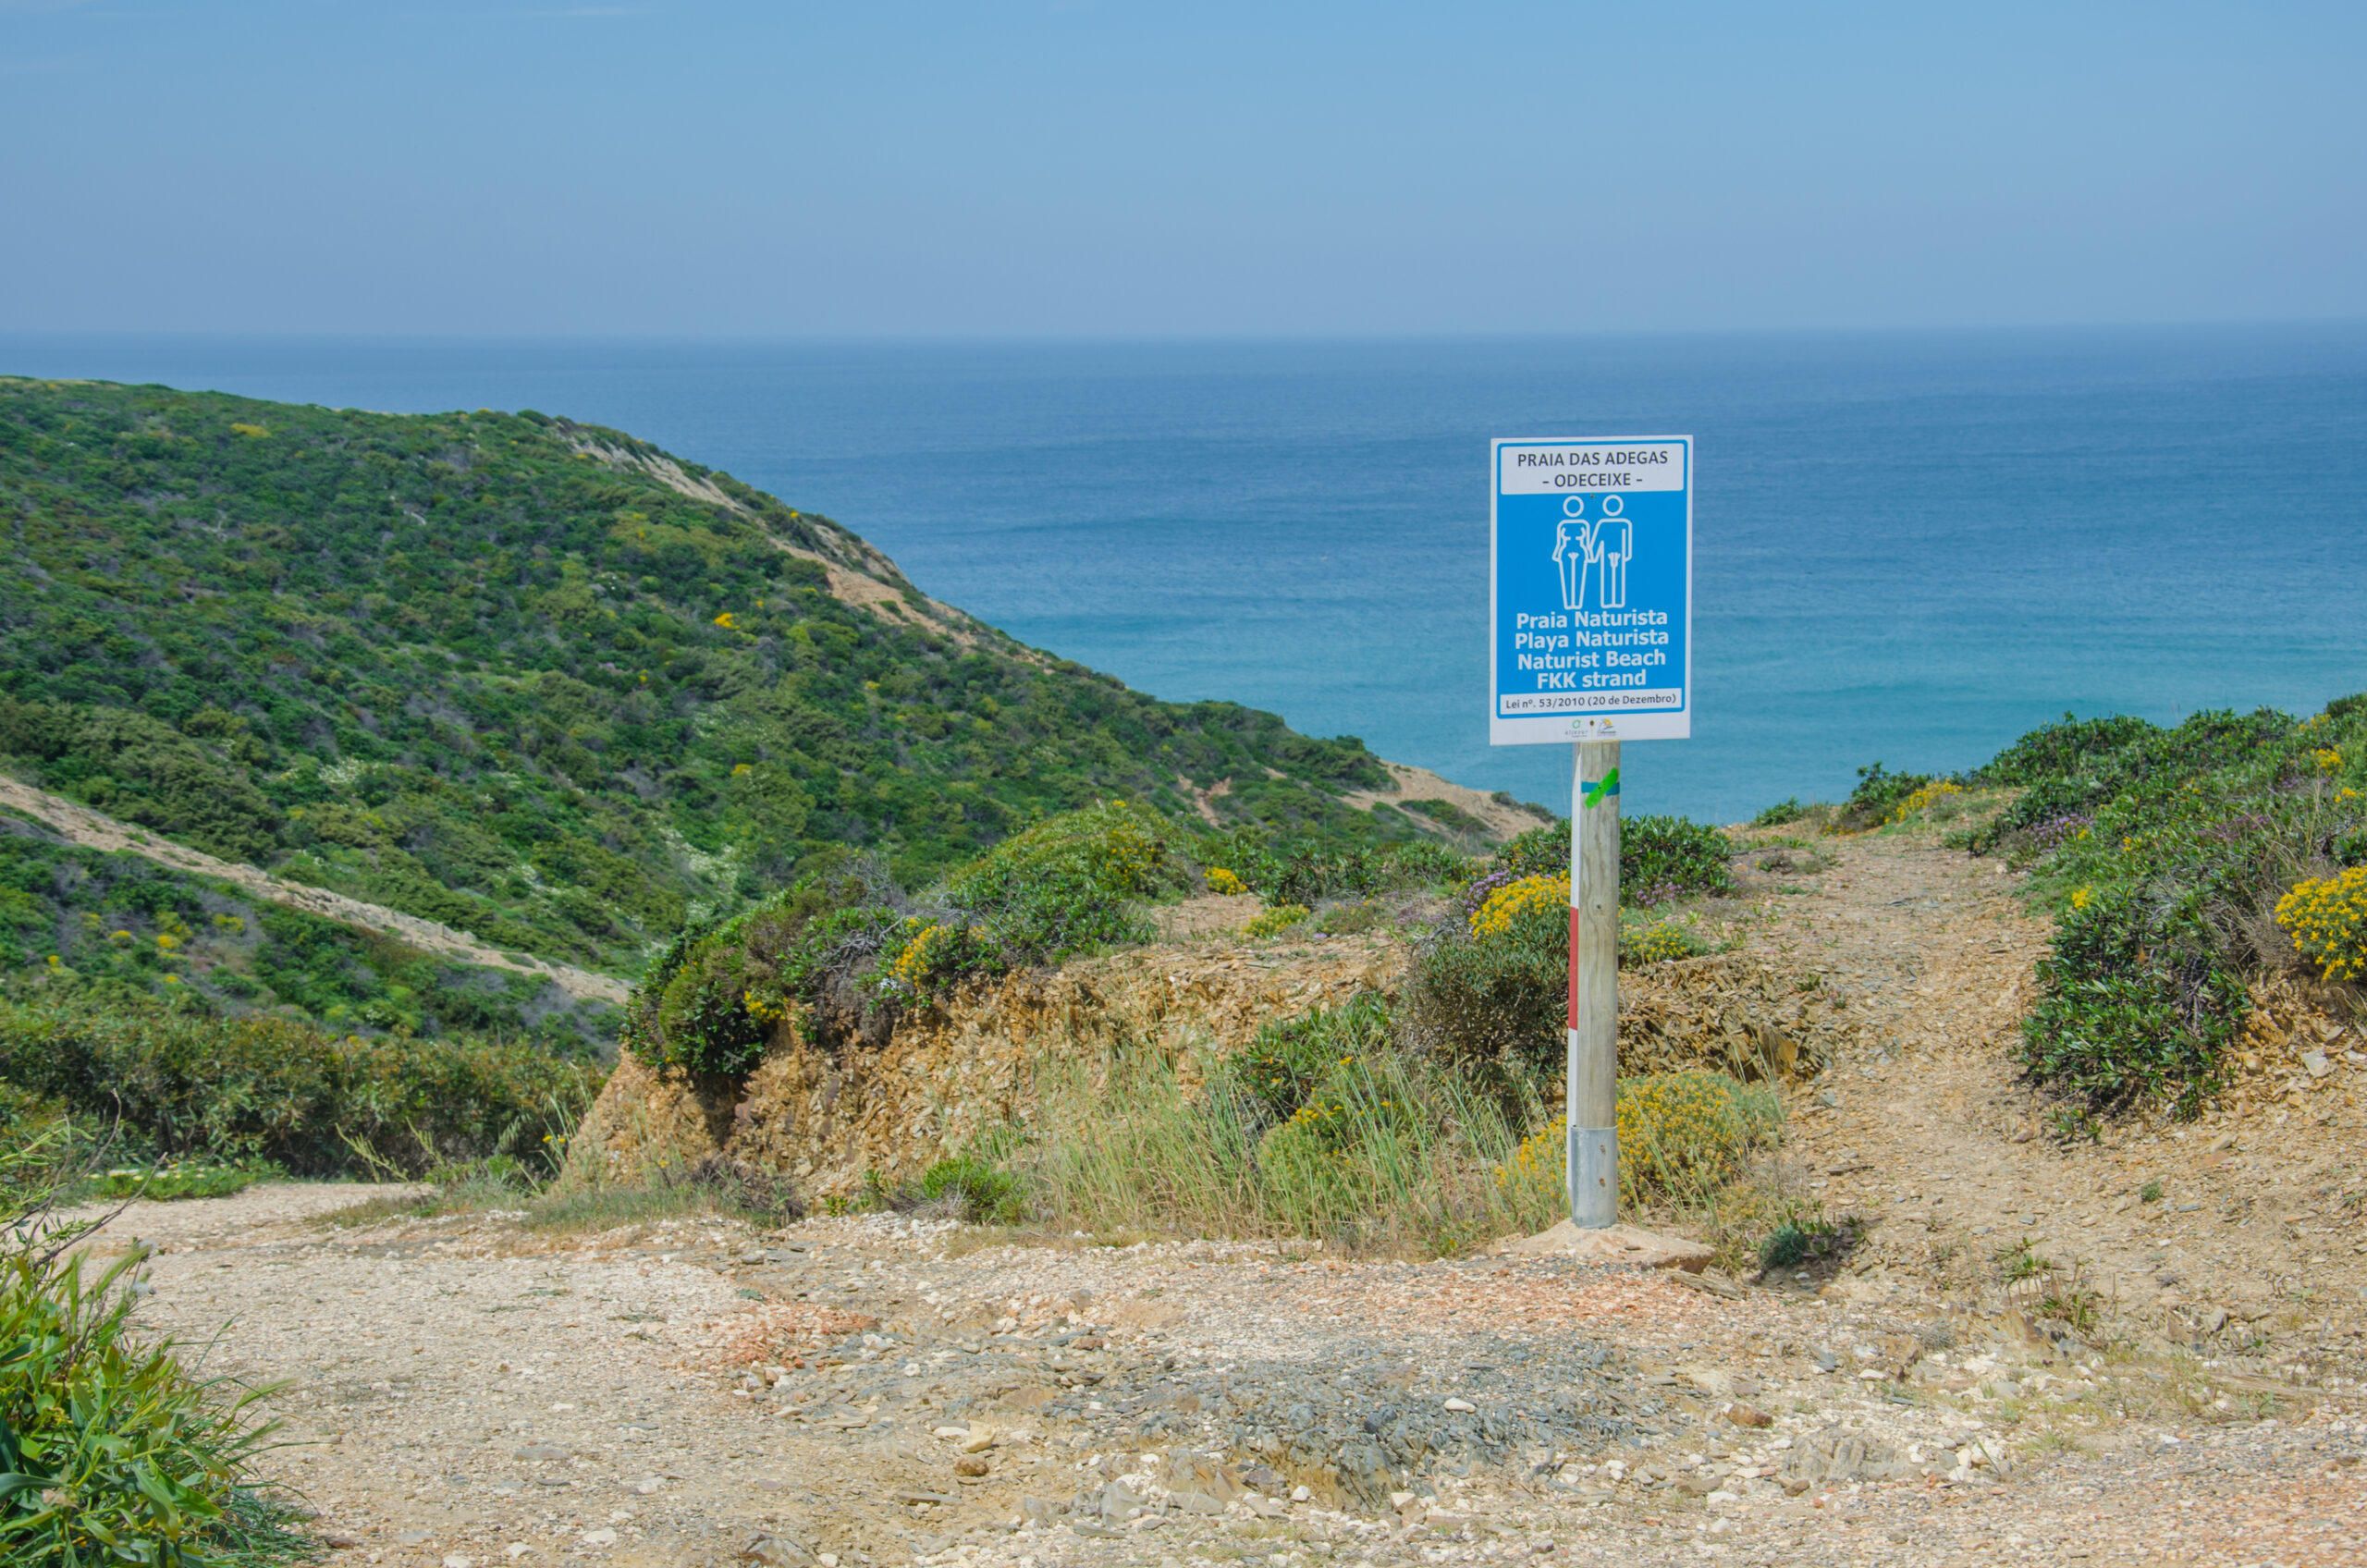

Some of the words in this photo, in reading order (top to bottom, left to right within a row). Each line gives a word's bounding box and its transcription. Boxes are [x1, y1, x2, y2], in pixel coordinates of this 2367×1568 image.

[1517, 453, 1564, 467] PRAIA
[1569, 452, 1600, 466] DAS
[1605, 450, 1669, 465] ADEGAS
[1554, 472, 1631, 487] ODECEIXE
[1516, 611, 1568, 630] Praia
[1575, 608, 1668, 628] Naturista
[1515, 631, 1569, 652] Playa
[1576, 629, 1669, 647] Naturista
[1517, 651, 1600, 670] Naturist
[1606, 648, 1666, 668] Beach
[1537, 671, 1576, 690] FKK
[1582, 668, 1647, 688] strand
[1506, 699, 1520, 709] Lei
[1539, 696, 1586, 709] 53/2010
[1588, 696, 1605, 708] (20
[1608, 694, 1620, 705] de
[1622, 692, 1677, 705] Dezembro)
